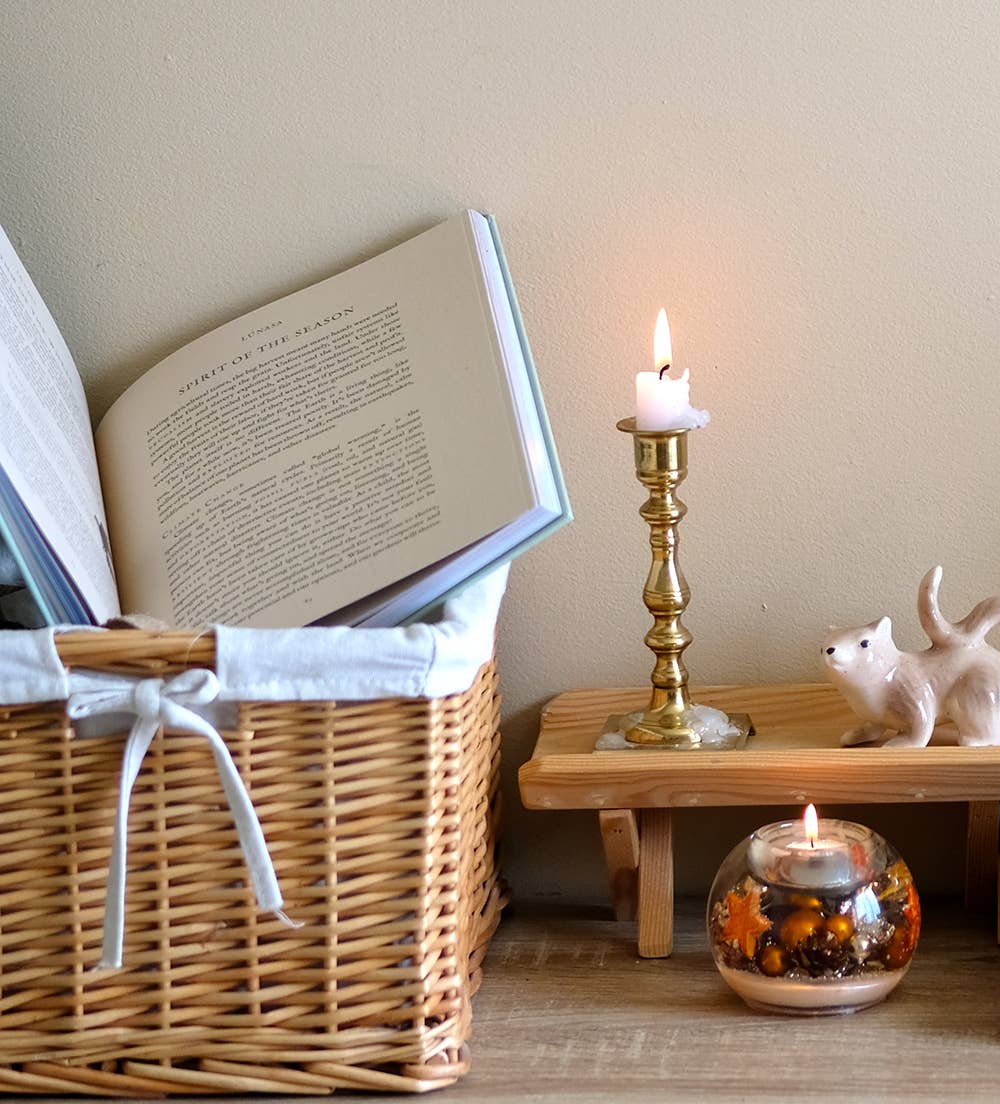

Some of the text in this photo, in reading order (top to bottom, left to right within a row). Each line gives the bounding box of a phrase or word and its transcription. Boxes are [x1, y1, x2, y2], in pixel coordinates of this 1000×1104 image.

[178, 305, 355, 396] SPIRIT OF THE SEASON
